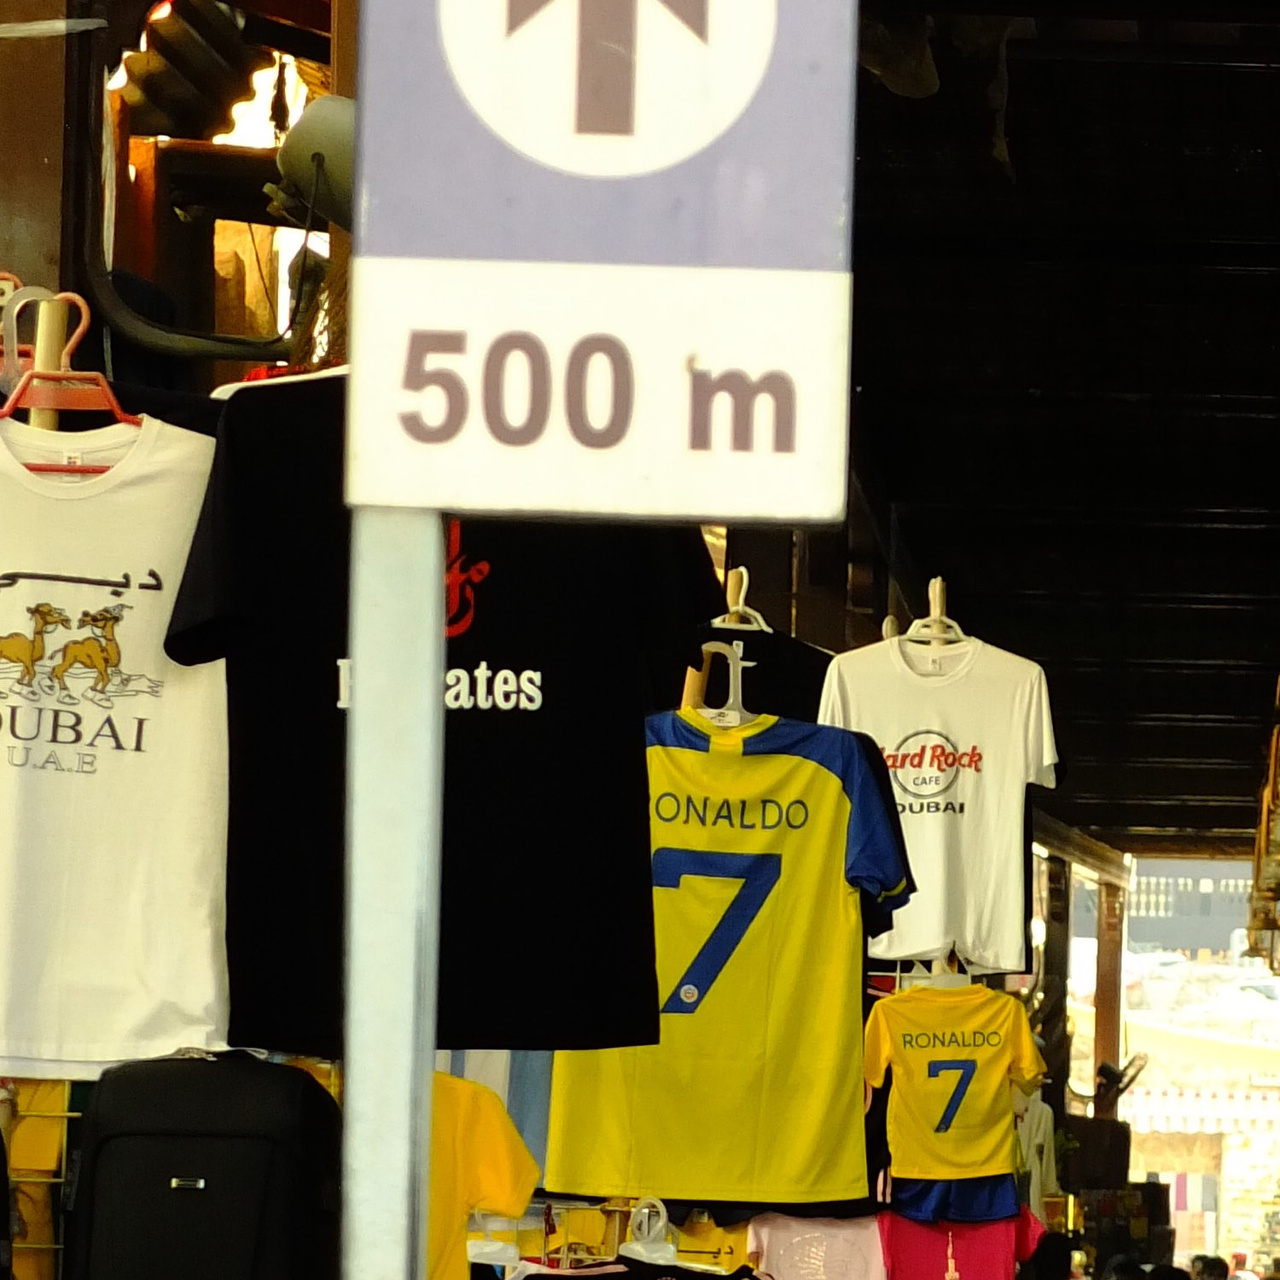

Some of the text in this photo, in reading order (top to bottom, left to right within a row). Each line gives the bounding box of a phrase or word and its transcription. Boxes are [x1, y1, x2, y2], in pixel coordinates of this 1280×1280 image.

[398, 329, 797, 453] 500 m
[336, 659, 543, 711] ates
[0, 704, 150, 753] UBAI
[880, 744, 983, 773] ard Rock
[913, 776, 941, 786] CAFE
[655, 792, 809, 830] ONALDO
[896, 801, 965, 815] DUBAI
[652, 847, 783, 1014] 7
[902, 1031, 1002, 1050] RONALDO
[928, 1060, 978, 1133] 7
